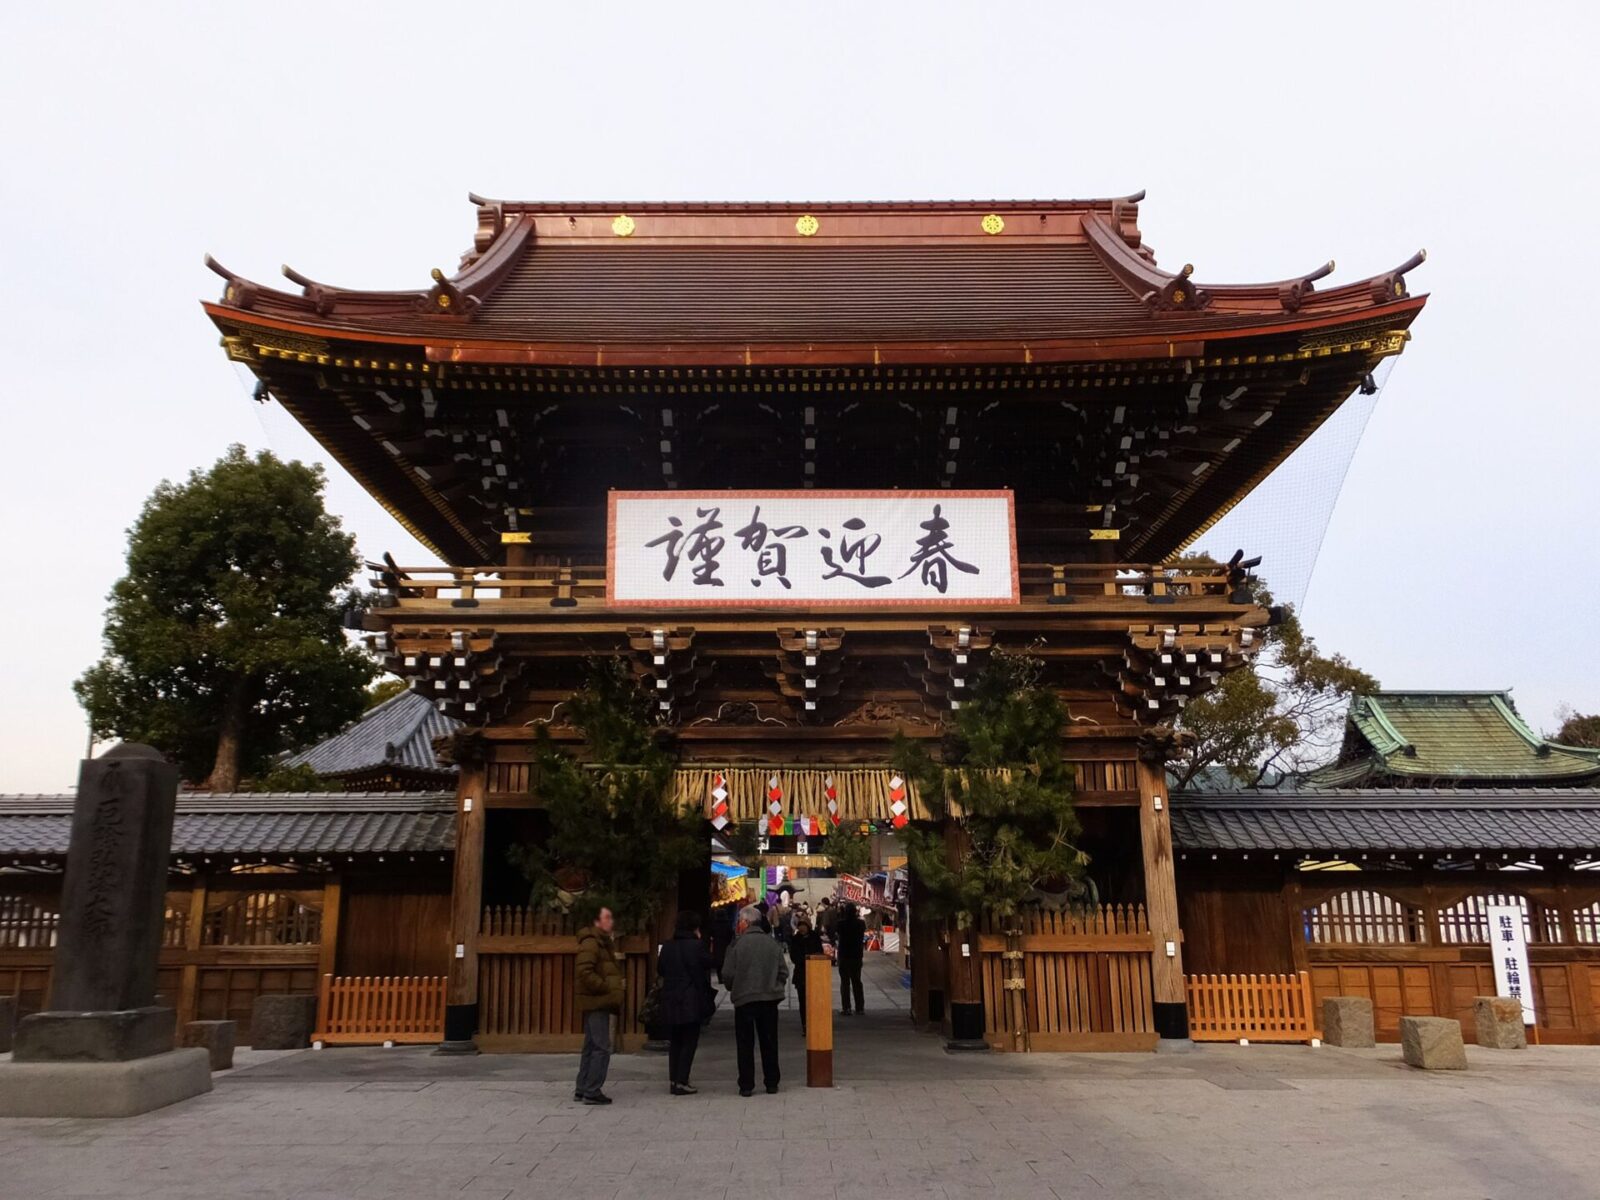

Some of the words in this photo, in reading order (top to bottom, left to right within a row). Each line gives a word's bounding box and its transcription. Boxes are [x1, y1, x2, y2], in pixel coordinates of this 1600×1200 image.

[644, 504, 980, 593] 謹賀迎春
[1499, 915, 1524, 1012] 駐車・駐輪禁
